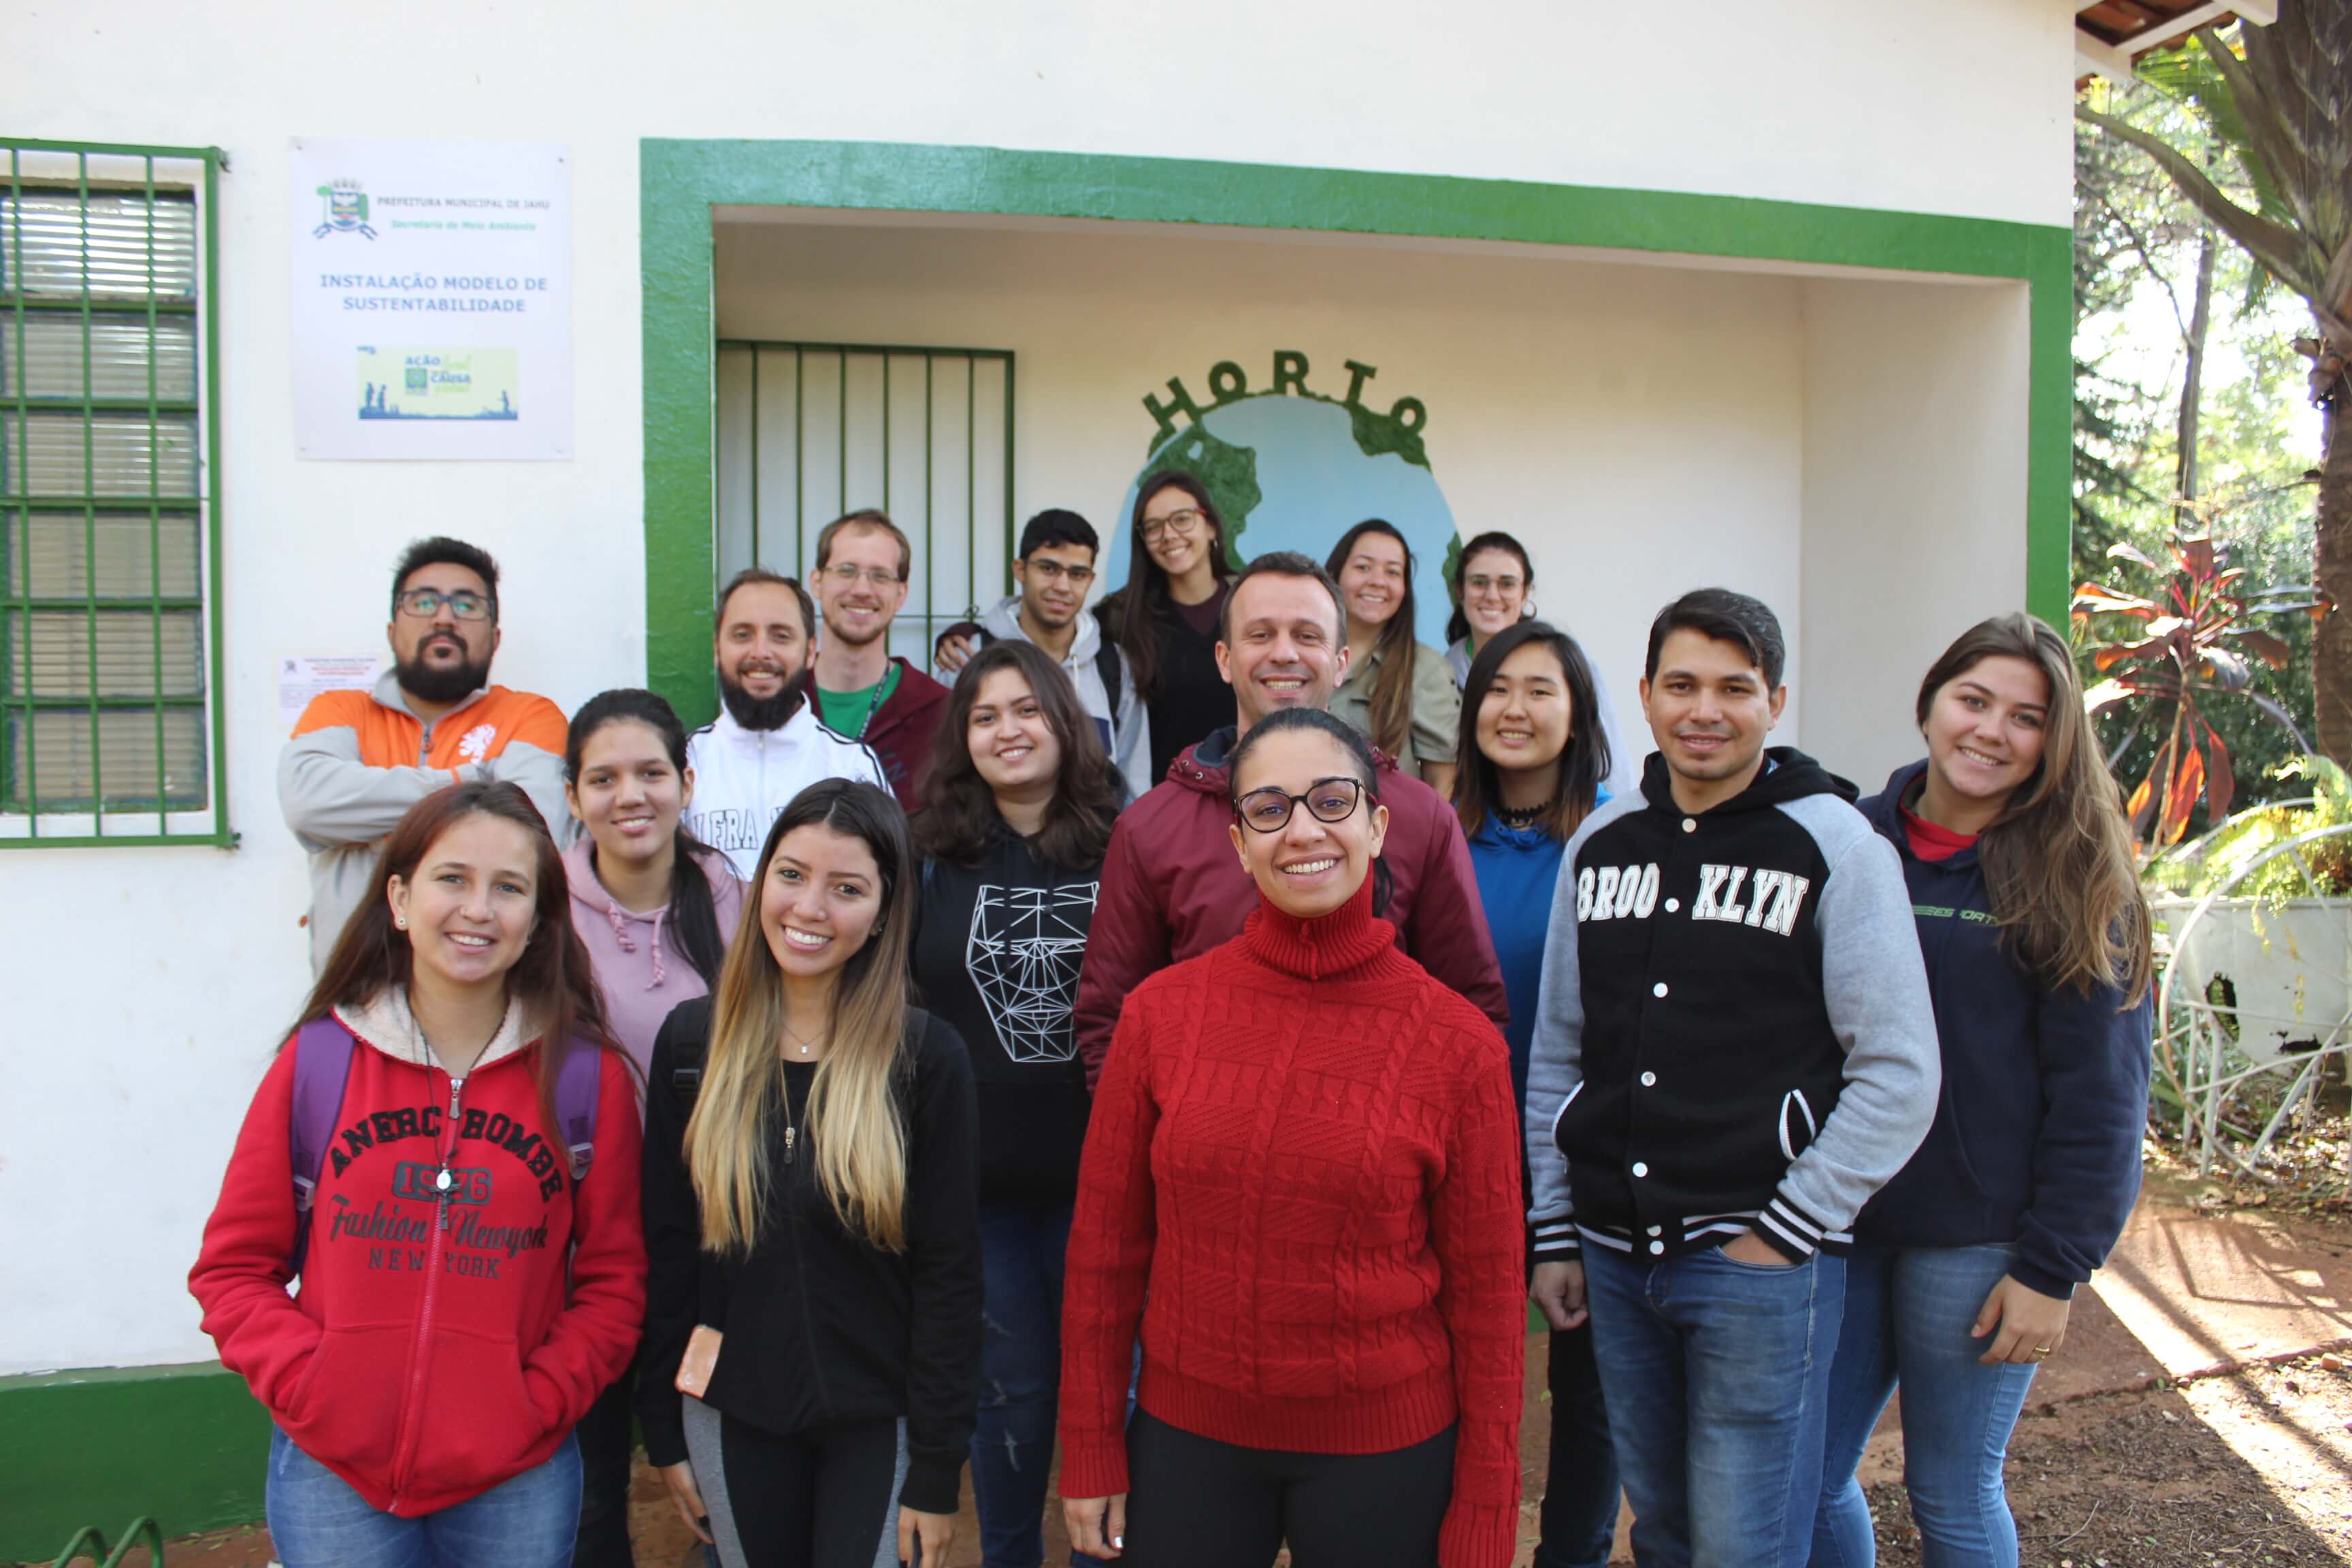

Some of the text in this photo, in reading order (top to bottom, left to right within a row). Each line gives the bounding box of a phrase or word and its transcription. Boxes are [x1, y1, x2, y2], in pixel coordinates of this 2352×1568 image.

[377, 197, 441, 207] PREFEITURA
[444, 198, 504, 208] MUNICIPAL
[506, 200, 519, 208] DE
[320, 272, 547, 291] INSTALAÇÃO MODELO DE
[343, 297, 526, 312] SUSTENTABILIDADE
[1141, 350, 1427, 436] HORTO
[369, 1248, 501, 1279] NEW YORK
